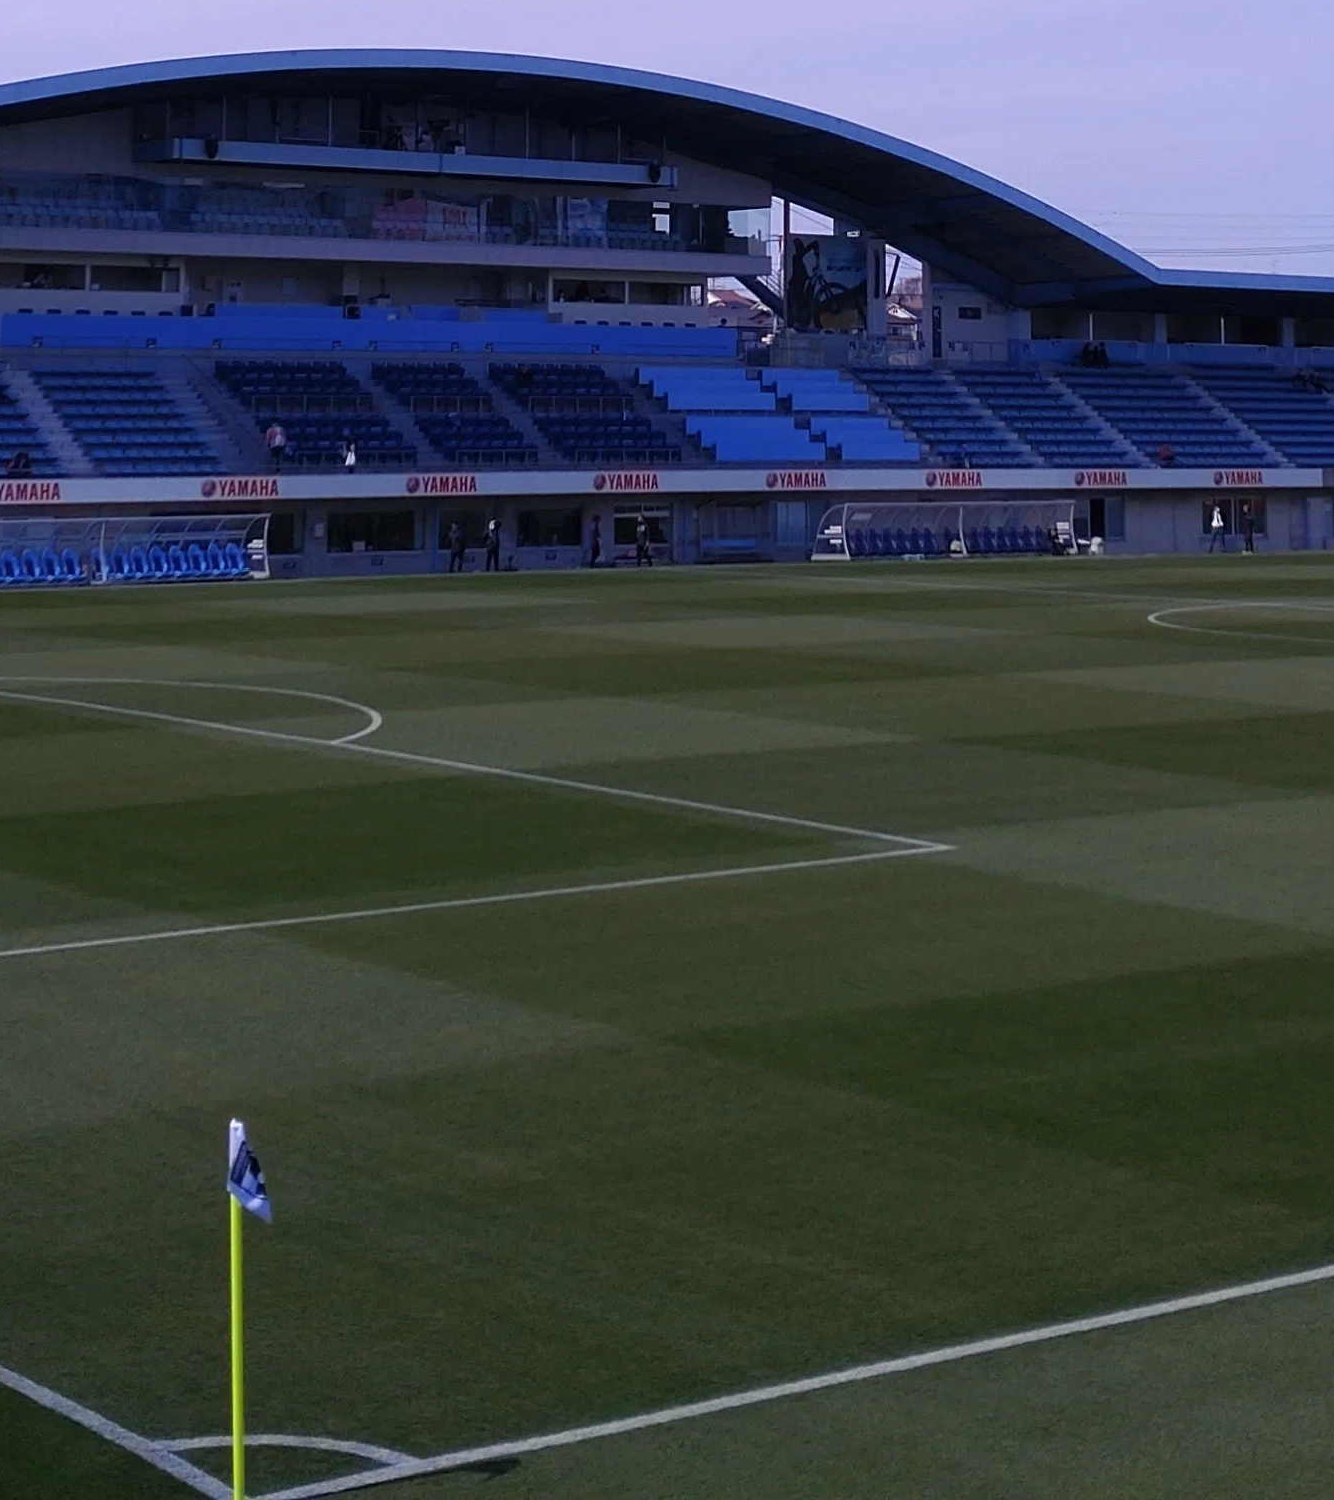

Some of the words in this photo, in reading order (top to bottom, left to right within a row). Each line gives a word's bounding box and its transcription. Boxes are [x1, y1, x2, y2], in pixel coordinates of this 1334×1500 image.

[422, 476, 477, 494] YAMAHA
[607, 473, 659, 490] YAMAHA
[779, 472, 826, 489] YAMAHA
[938, 471, 983, 488] YAMAHA
[1086, 471, 1127, 487] YAMAHA
[1224, 470, 1263, 486] YAMAHA
[218, 479, 279, 498] YAMAHA
